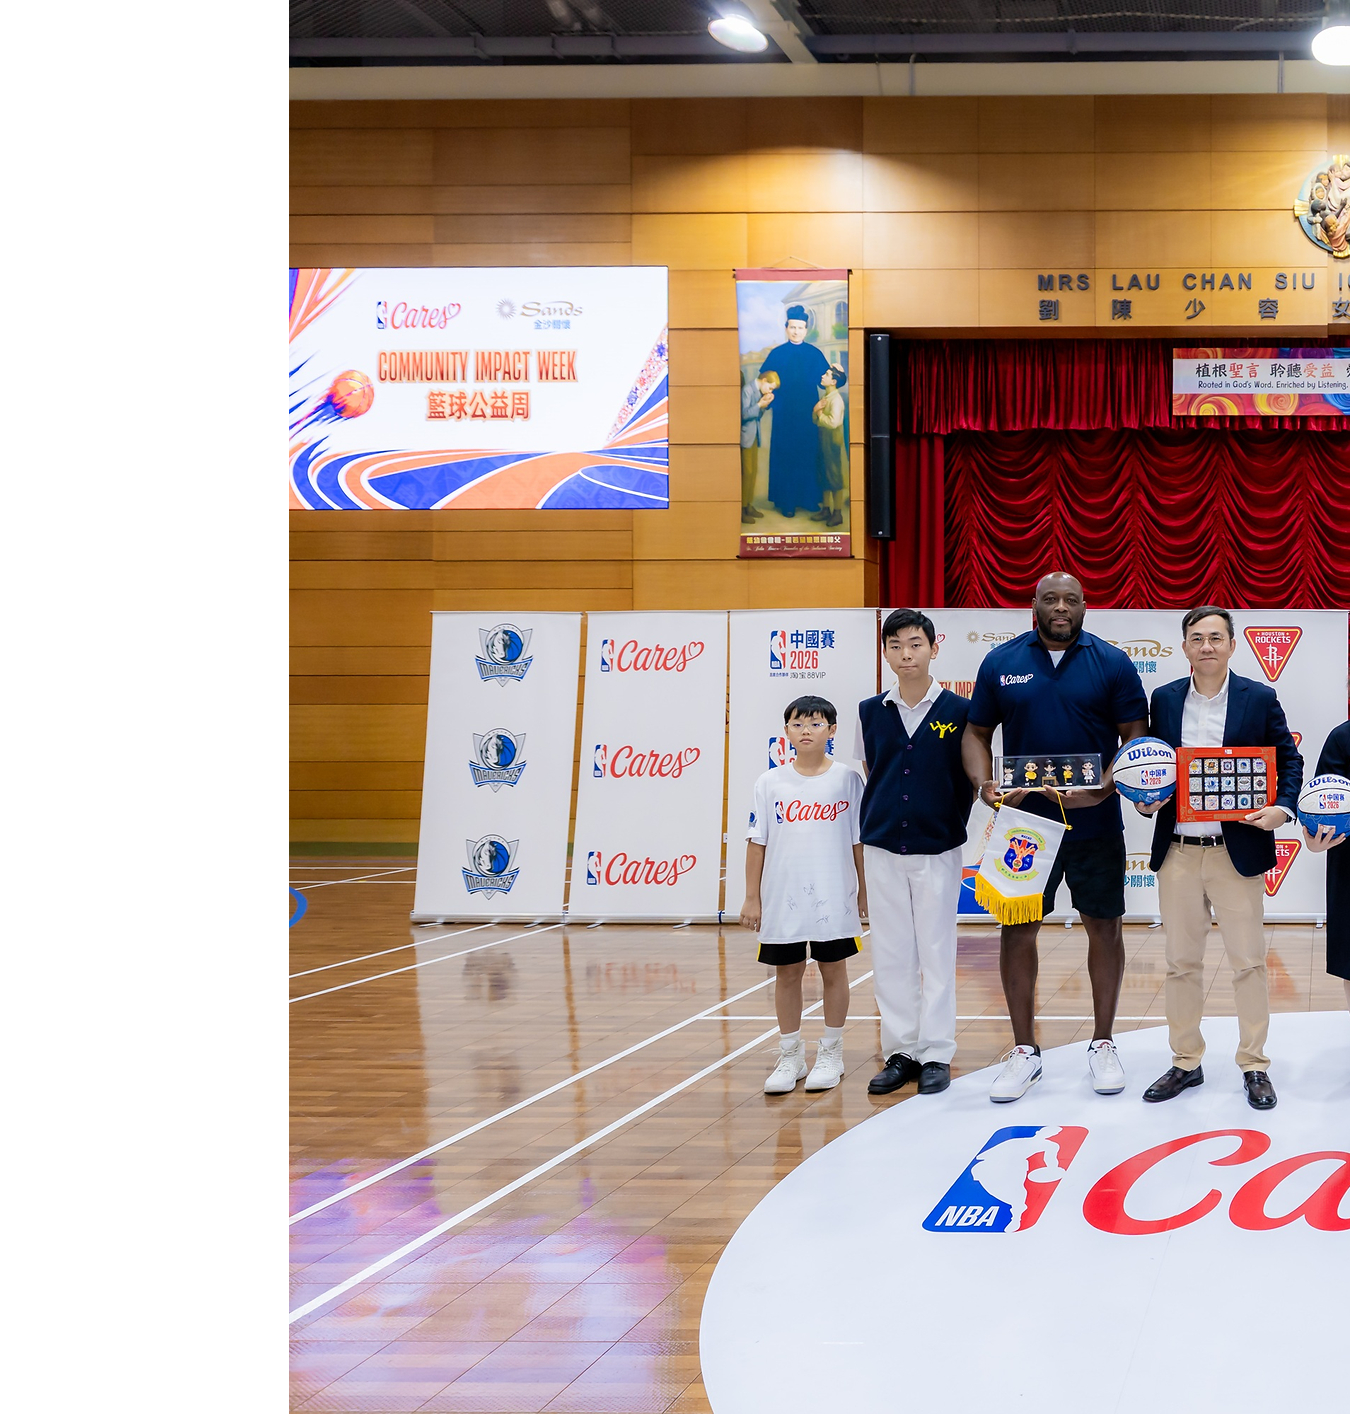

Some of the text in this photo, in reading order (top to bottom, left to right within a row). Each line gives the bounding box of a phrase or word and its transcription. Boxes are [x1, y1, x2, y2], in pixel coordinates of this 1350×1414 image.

[1037, 273, 1090, 291] MRS
[1112, 273, 1160, 291] LAU
[1183, 273, 1252, 290] CHAN
[1275, 272, 1315, 290] SIU
[391, 302, 461, 329] Cares
[520, 301, 583, 317] Sands
[378, 351, 577, 382] COMMUNITY IMPACT WEEK
[1195, 362, 1260, 379] 植根聖言
[1270, 362, 1335, 379] 聆聽受益
[1198, 381, 1222, 389] Rooted
[1233, 381, 1252, 389] God's
[1276, 381, 1305, 389] Enriched
[1307, 381, 1316, 390] by
[427, 391, 530, 419] 籃球公益周
[790, 629, 835, 649] 中國賽
[1107, 639, 1173, 657] ands
[618, 639, 705, 672] Cares
[790, 650, 819, 669] 2026
[1006, 673, 1034, 685] Cares
[610, 745, 701, 778] Cares
[1127, 747, 1172, 761] Wilson
[786, 800, 849, 822] Cares
[605, 852, 697, 886] Cares
[935, 1205, 999, 1227] NBA
